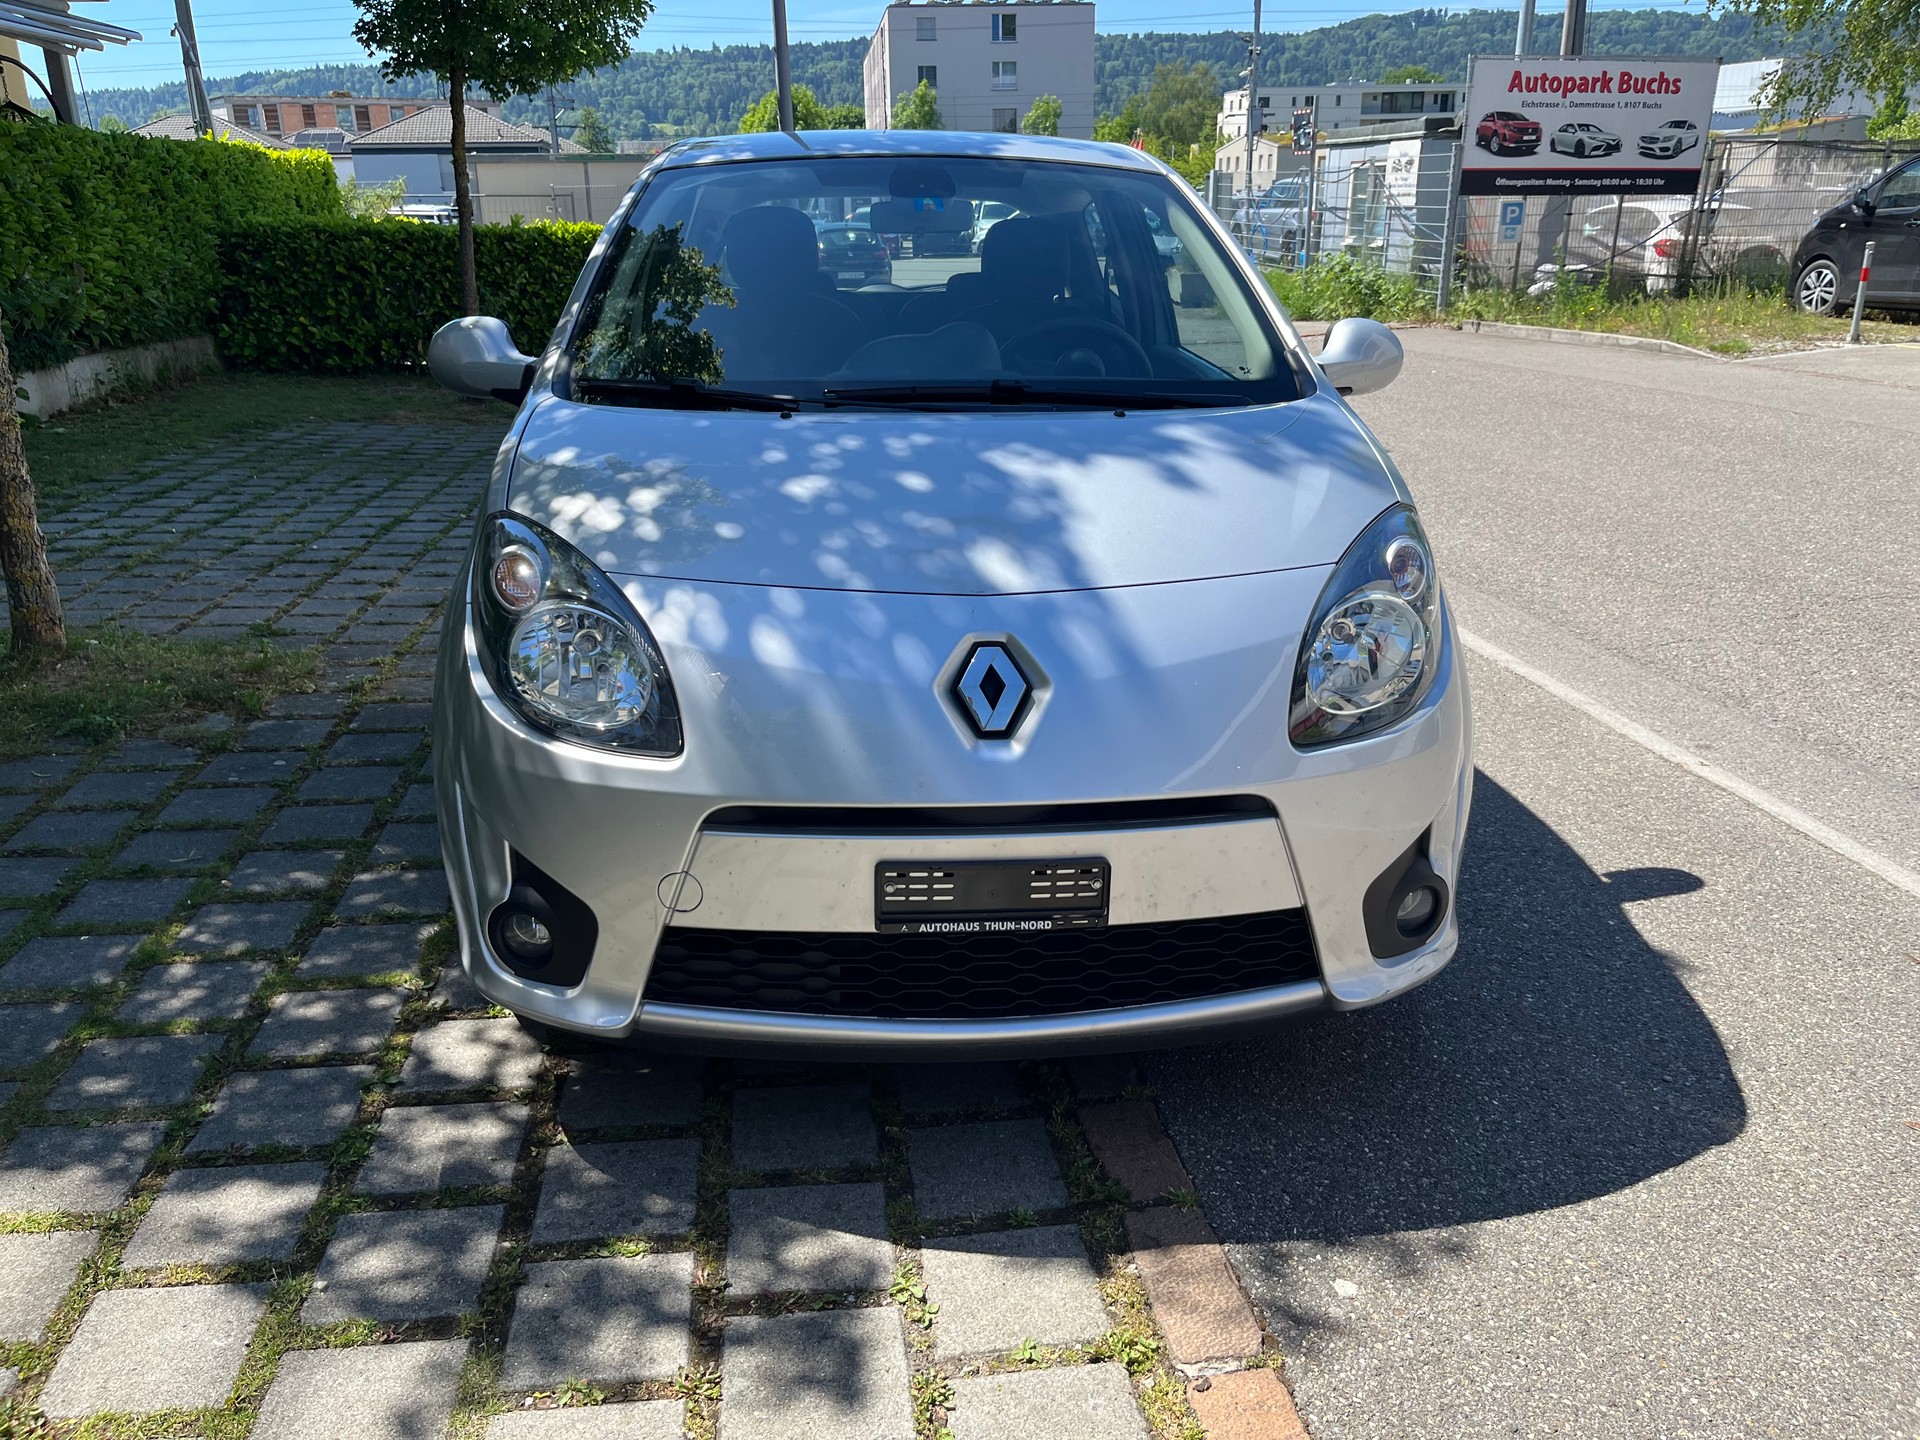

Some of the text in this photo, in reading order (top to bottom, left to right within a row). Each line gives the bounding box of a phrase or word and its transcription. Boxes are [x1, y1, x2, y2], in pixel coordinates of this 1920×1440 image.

[1508, 70, 1682, 98] Autopark Buchs
[1521, 100, 1560, 109] Eichstrasse
[1569, 101, 1615, 109] Dammstrasse
[1617, 101, 1623, 109] 1,
[1624, 101, 1641, 109] 8107
[1642, 101, 1662, 109] Buchs
[1495, 177, 1545, 187] Öffnungszeiten:
[1546, 178, 1570, 187] Montag
[1574, 178, 1601, 187] Samstag
[1602, 178, 1619, 186] 08:00
[1505, 206, 1520, 223] P
[918, 920, 1052, 933] AUTOHAUS THUN-NORD
